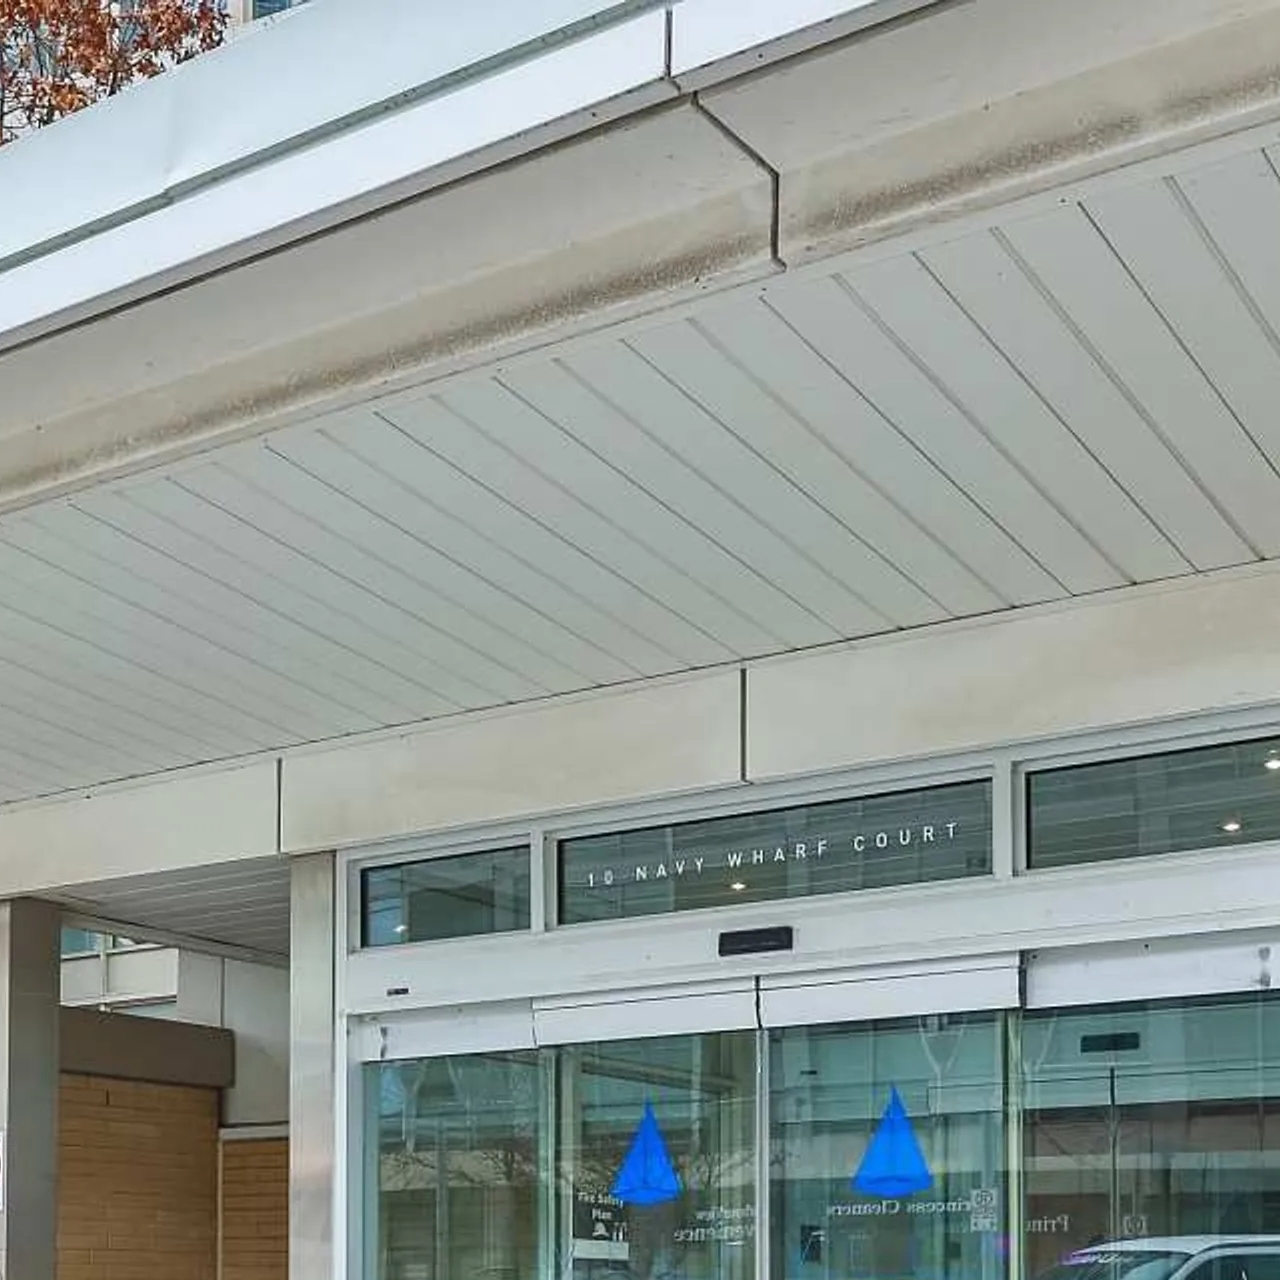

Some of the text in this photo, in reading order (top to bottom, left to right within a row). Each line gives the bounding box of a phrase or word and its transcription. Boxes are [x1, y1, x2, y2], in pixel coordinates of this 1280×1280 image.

[587, 822, 959, 887] 10 NAVY WHARF COURT
